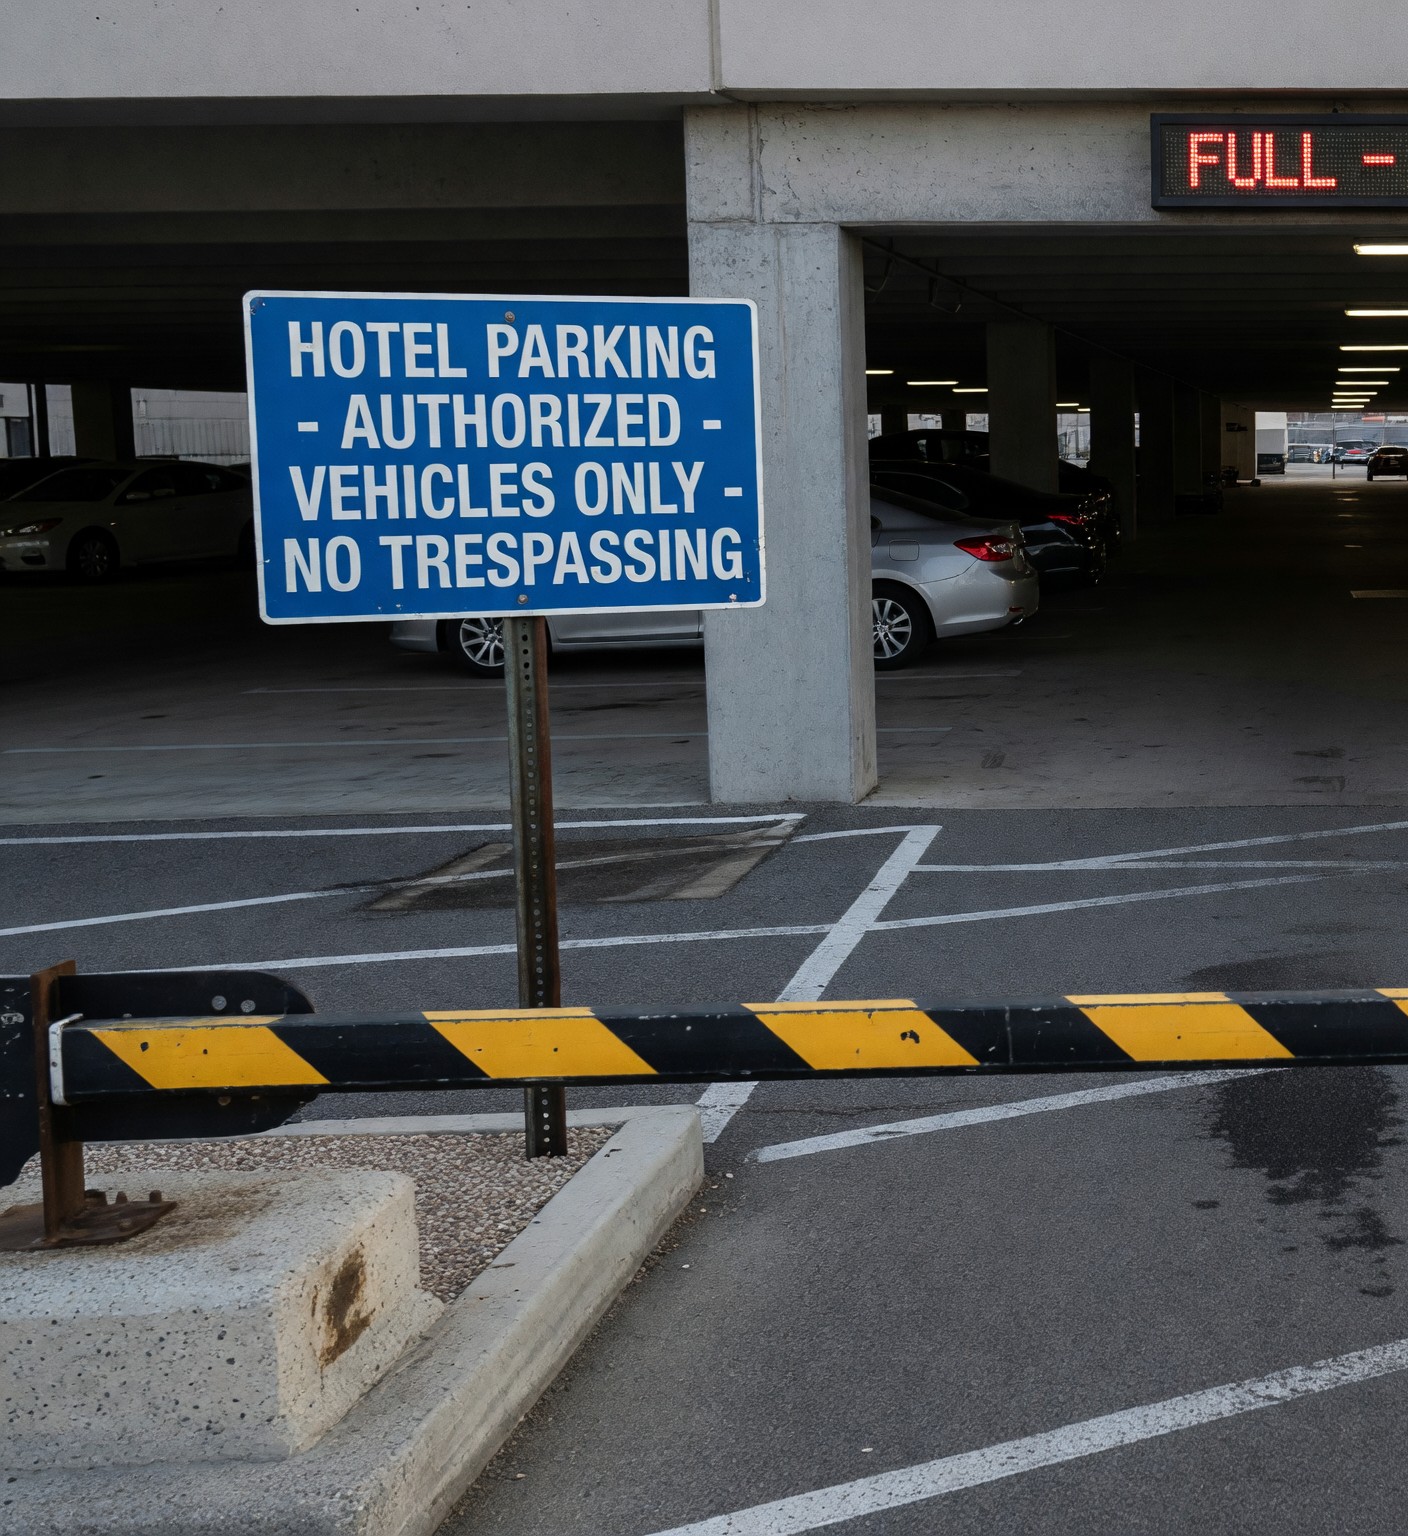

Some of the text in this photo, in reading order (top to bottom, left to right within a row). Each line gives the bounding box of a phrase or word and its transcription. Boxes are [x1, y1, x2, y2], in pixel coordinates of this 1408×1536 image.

[1188, 132, 1338, 188] FULL
[1362, 153, 1396, 166] -
[288, 320, 716, 380] HOTEL PARKING
[297, 393, 722, 450] - AUTHORIZED -
[289, 461, 743, 521] VEHICLES ONLY -
[284, 527, 744, 593] NO TRESPASSING
